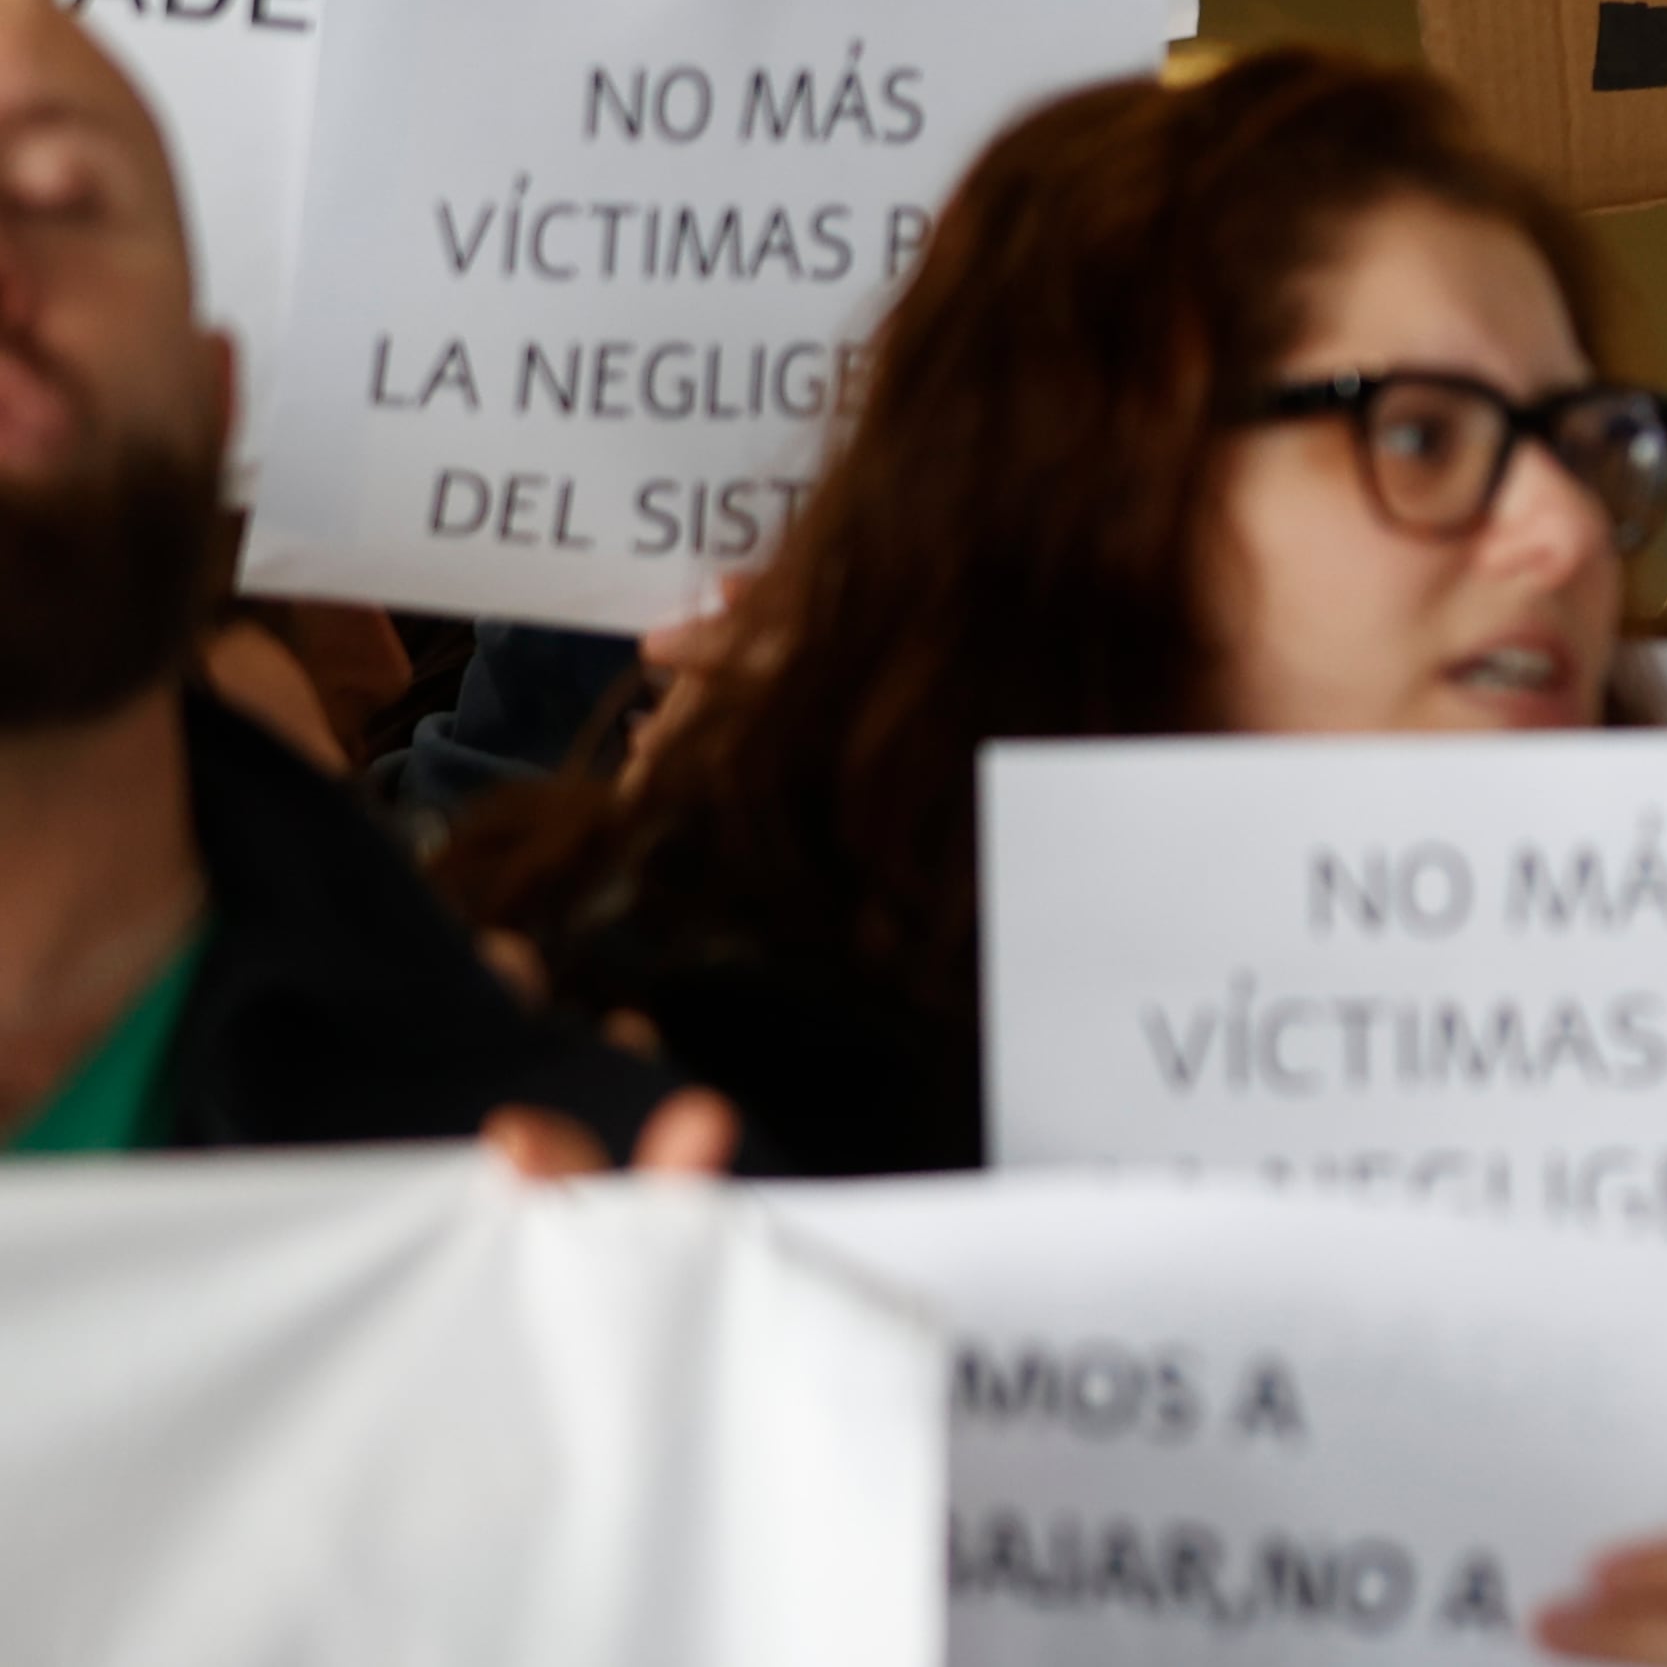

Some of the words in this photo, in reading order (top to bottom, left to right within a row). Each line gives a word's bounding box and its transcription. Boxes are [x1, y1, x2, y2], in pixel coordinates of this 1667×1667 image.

[581, 63, 714, 144] NO
[739, 37, 926, 146] MÁS
[434, 170, 854, 284] VÍCTIMAS
[367, 332, 480, 412] LA
[515, 337, 876, 420] NEGLIGE
[427, 466, 595, 550] DEL
[630, 473, 814, 559] SIST
[1305, 839, 1475, 937] NO
